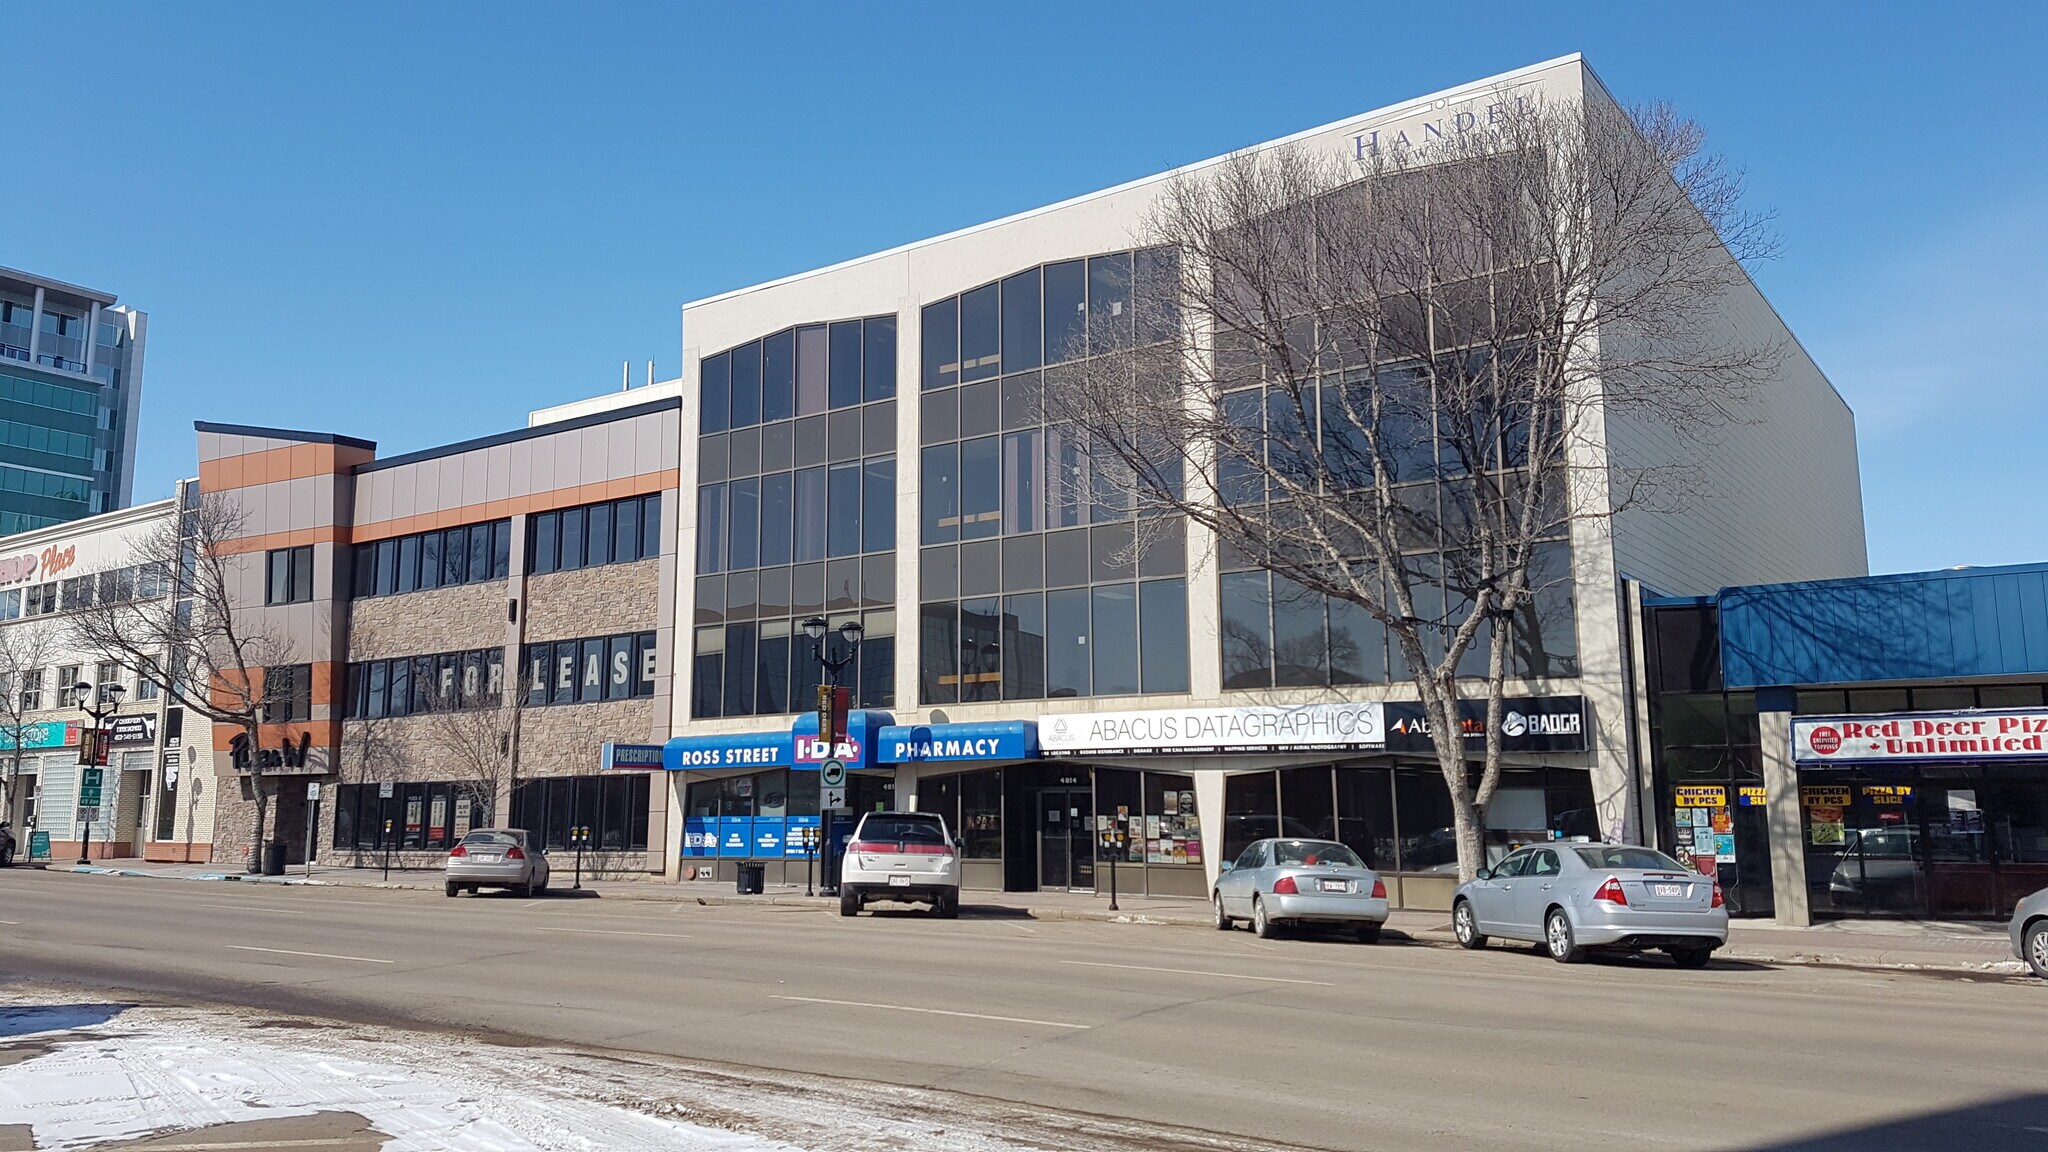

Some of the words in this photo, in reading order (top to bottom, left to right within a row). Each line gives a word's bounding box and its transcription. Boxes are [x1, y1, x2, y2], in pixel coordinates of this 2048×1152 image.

[1353, 96, 1535, 162] HANDEL
[40, 544, 76, 582] Place
[532, 648, 656, 691] LEASE
[440, 663, 503, 698] FOR
[1089, 717, 1178, 741] ABACUS
[1186, 710, 1374, 739] DATAGRAPHICS
[1529, 714, 1581, 733] BADGR
[1842, 721, 1900, 738] Red
[1912, 720, 1986, 736] Deer
[1048, 733, 1075, 742] ABACUS
[1885, 735, 2042, 754] Unlimited
[615, 748, 663, 763] PRESCRIPTION
[682, 750, 720, 766] ROSS
[725, 747, 779, 764] STREET
[895, 739, 1000, 758] PHARMACY
[85, 771, 100, 785] H
[1676, 788, 1723, 796] CHICKEN
[1802, 787, 1849, 796] CHICKEN
[1862, 787, 1893, 796] PIZZA
[1896, 786, 1912, 796] BY
[1808, 797, 1820, 805] BY
[1824, 797, 1844, 805] PCS
[1873, 796, 1903, 805] SLICE
